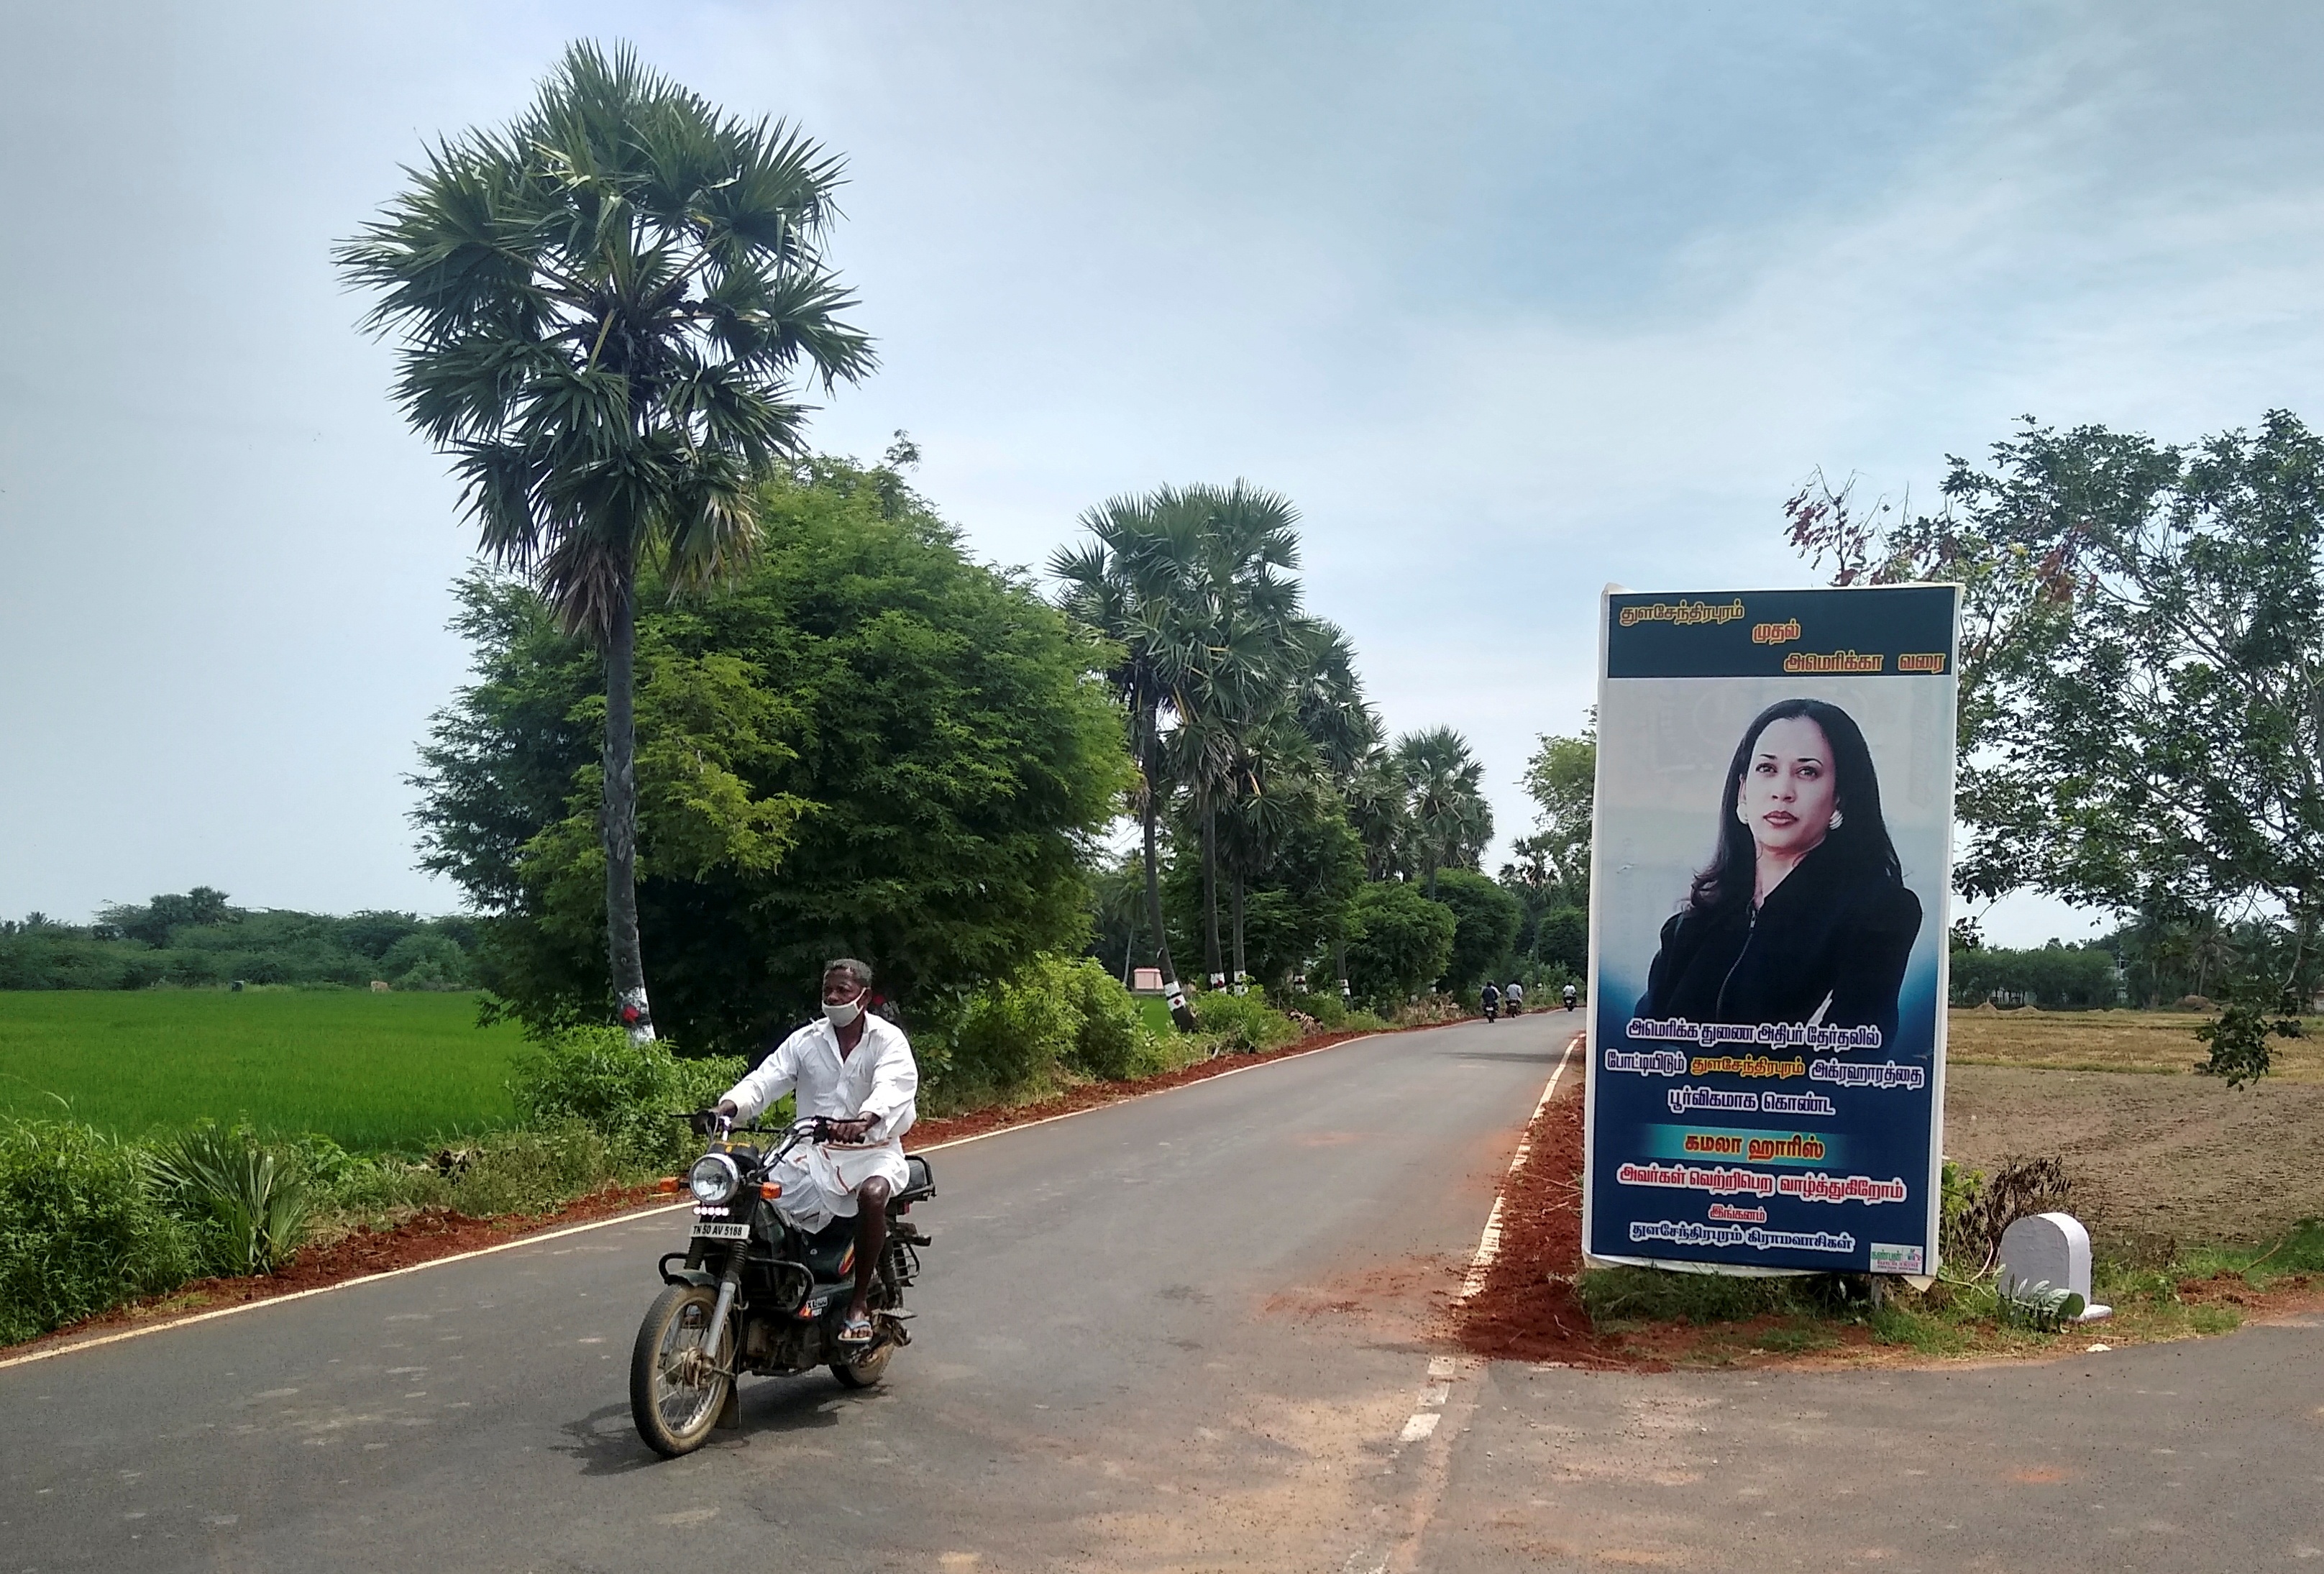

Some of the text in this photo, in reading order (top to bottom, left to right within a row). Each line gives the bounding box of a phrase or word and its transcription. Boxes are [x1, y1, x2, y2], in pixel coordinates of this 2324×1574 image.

[1621, 599, 1744, 625] துளசேந்திரபுரம்
[1753, 619, 1800, 644] முதல்
[1785, 651, 1945, 673] அமெரிக்கா வரை
[1627, 1018, 1880, 1051] அமெரிக்க துணை அதிபர் தேர்தலில்
[1606, 1050, 1923, 1089] போட்டியிடும் துளசேந்திரபுரம் அக்ரஹாரத்தை
[1763, 1092, 1834, 1114] கொண்ட
[1685, 1133, 1825, 1161] கமலா ஹாரிஸ்
[1619, 1164, 1905, 1203] அவர்கள் வெற்றிபெற வாழ்த்துகிறோம்
[693, 1225, 742, 1236] TN 50 AV 5188
[1631, 1222, 1854, 1250] துளசேந்திரபுரம் கிராமவாசிகள்
